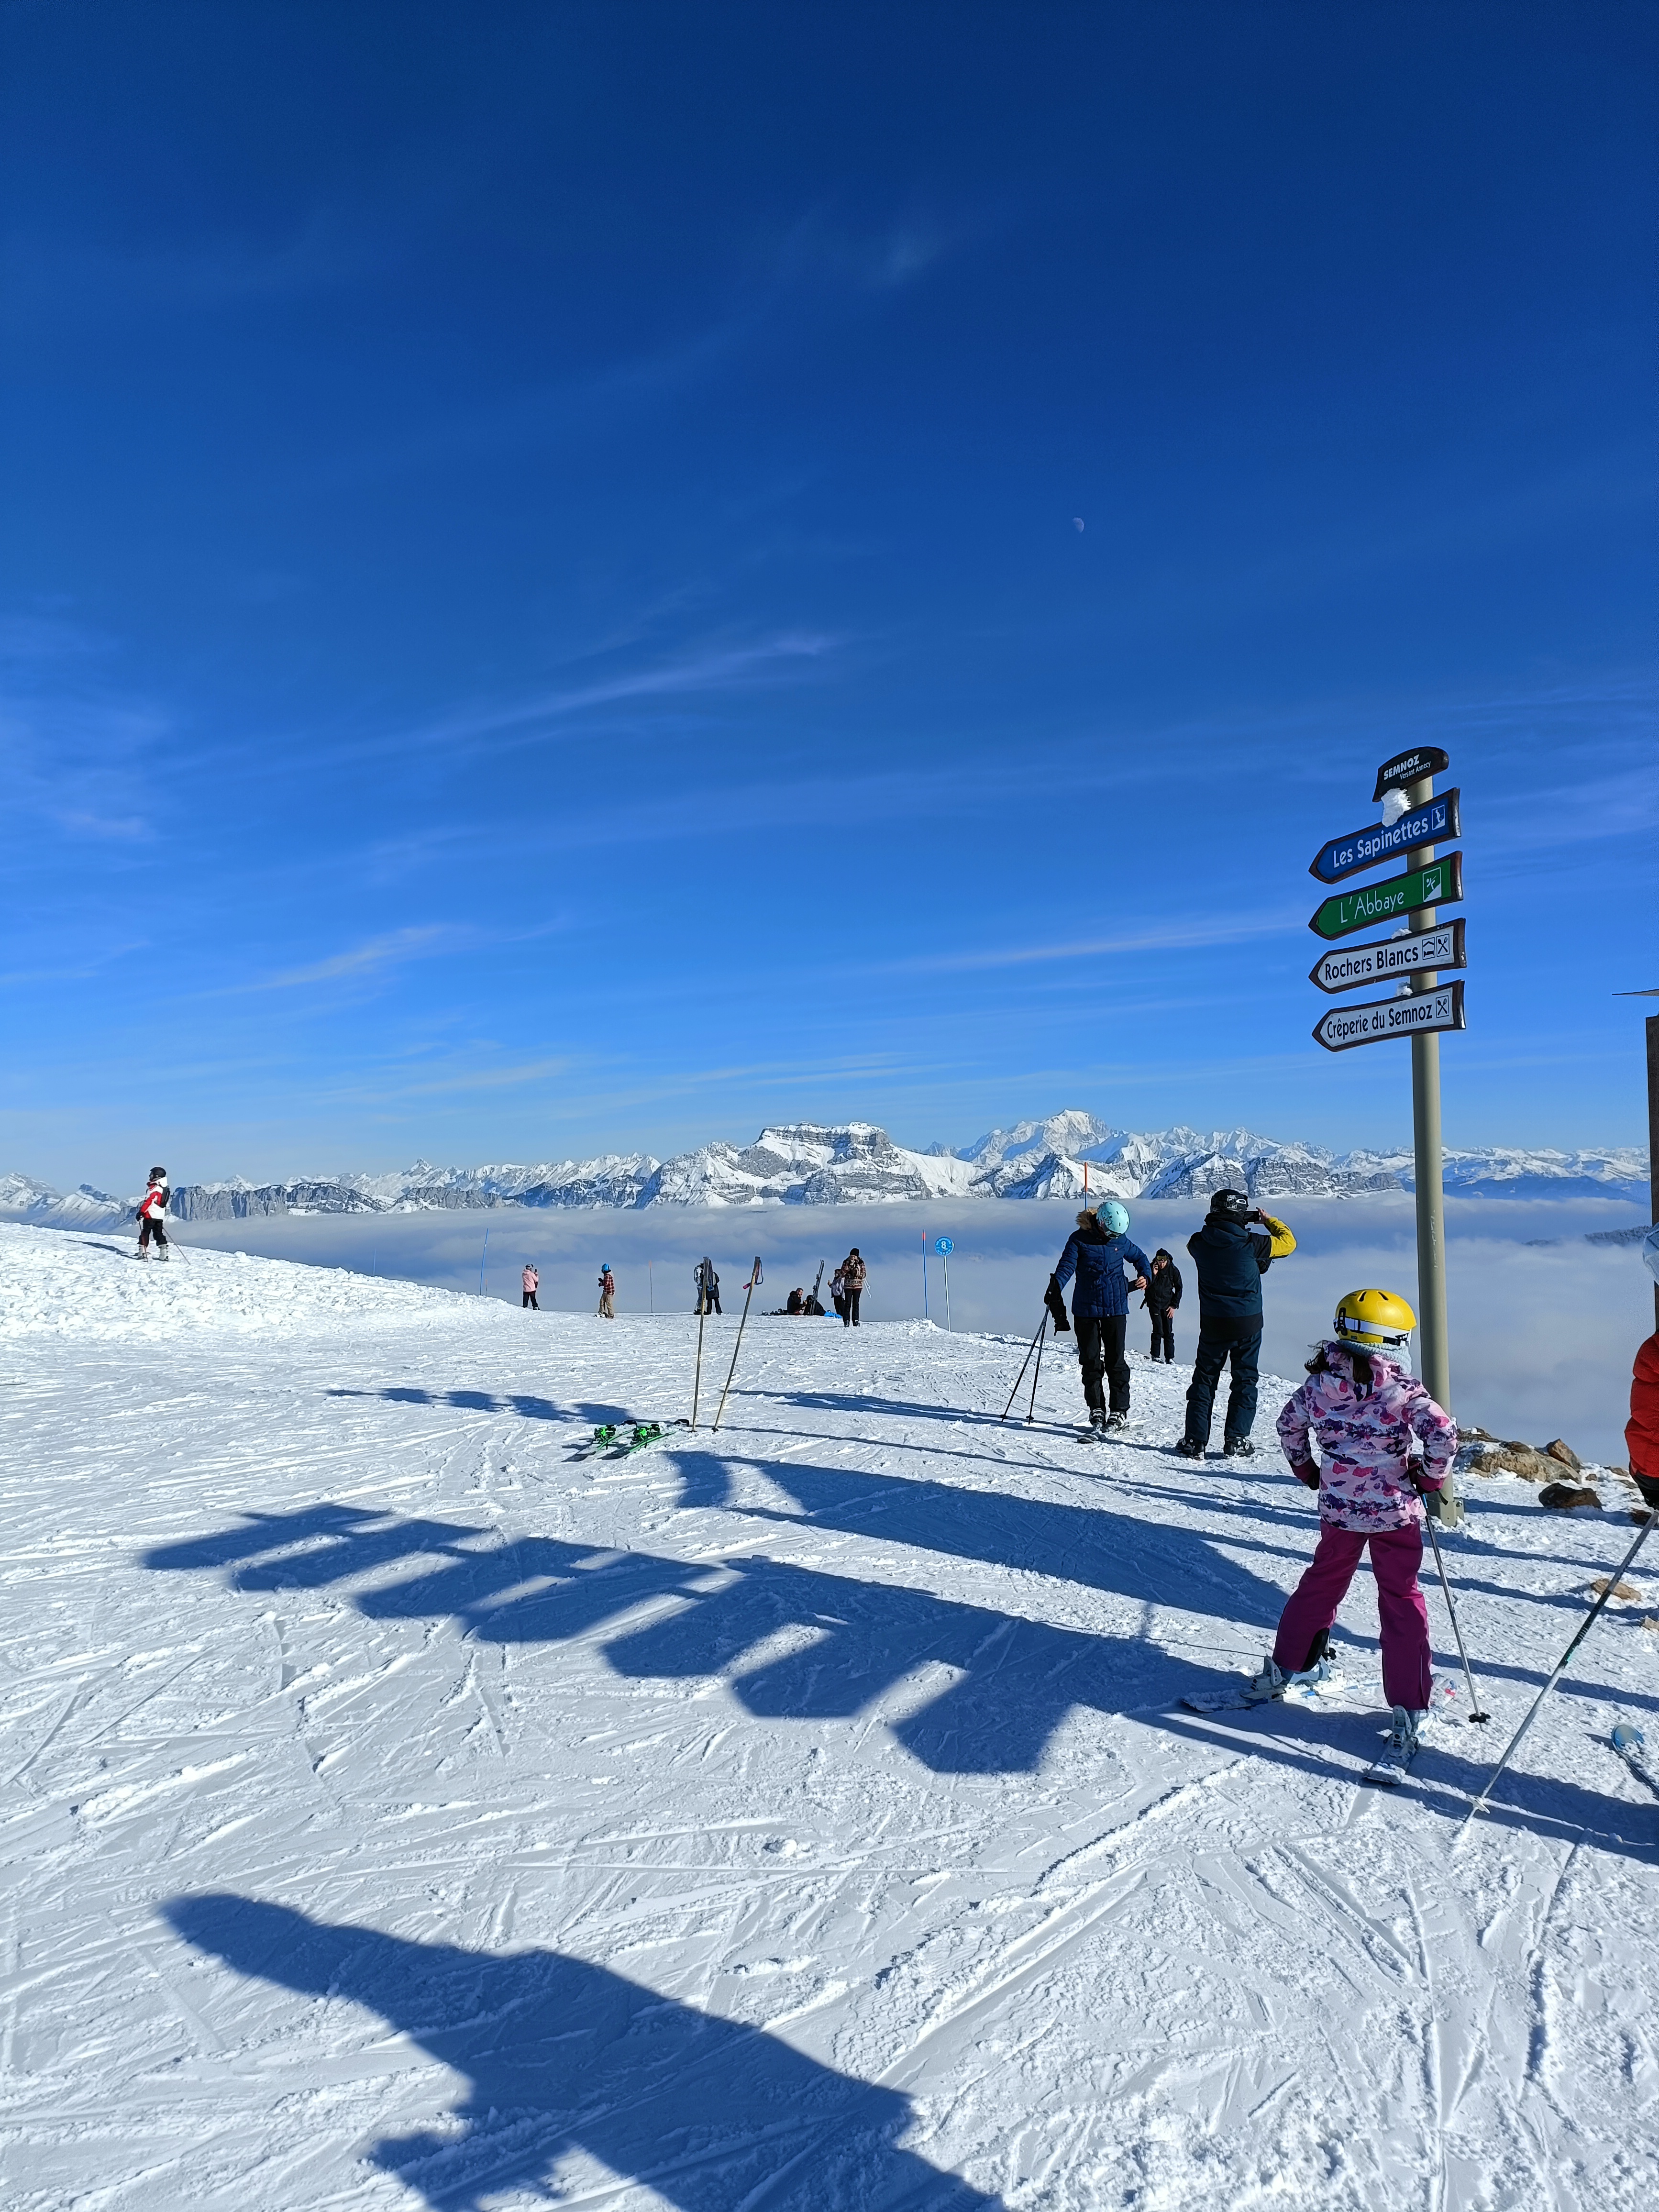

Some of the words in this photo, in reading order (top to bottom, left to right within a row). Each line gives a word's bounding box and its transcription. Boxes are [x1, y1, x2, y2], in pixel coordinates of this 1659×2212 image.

[1384, 754, 1419, 780] SEMNOZ
[1400, 768, 1415, 780] Versant
[1416, 761, 1431, 773] Annecy
[1334, 848, 1353, 868] Les
[1357, 817, 1428, 857] Sapinettes
[1340, 891, 1404, 923] L'Abbaye
[1325, 957, 1371, 981] Rochers
[1377, 947, 1418, 969] Blancs
[1327, 1015, 1369, 1040] Crêperie
[1372, 1011, 1385, 1030] du
[1389, 1005, 1432, 1027] Semnoz
